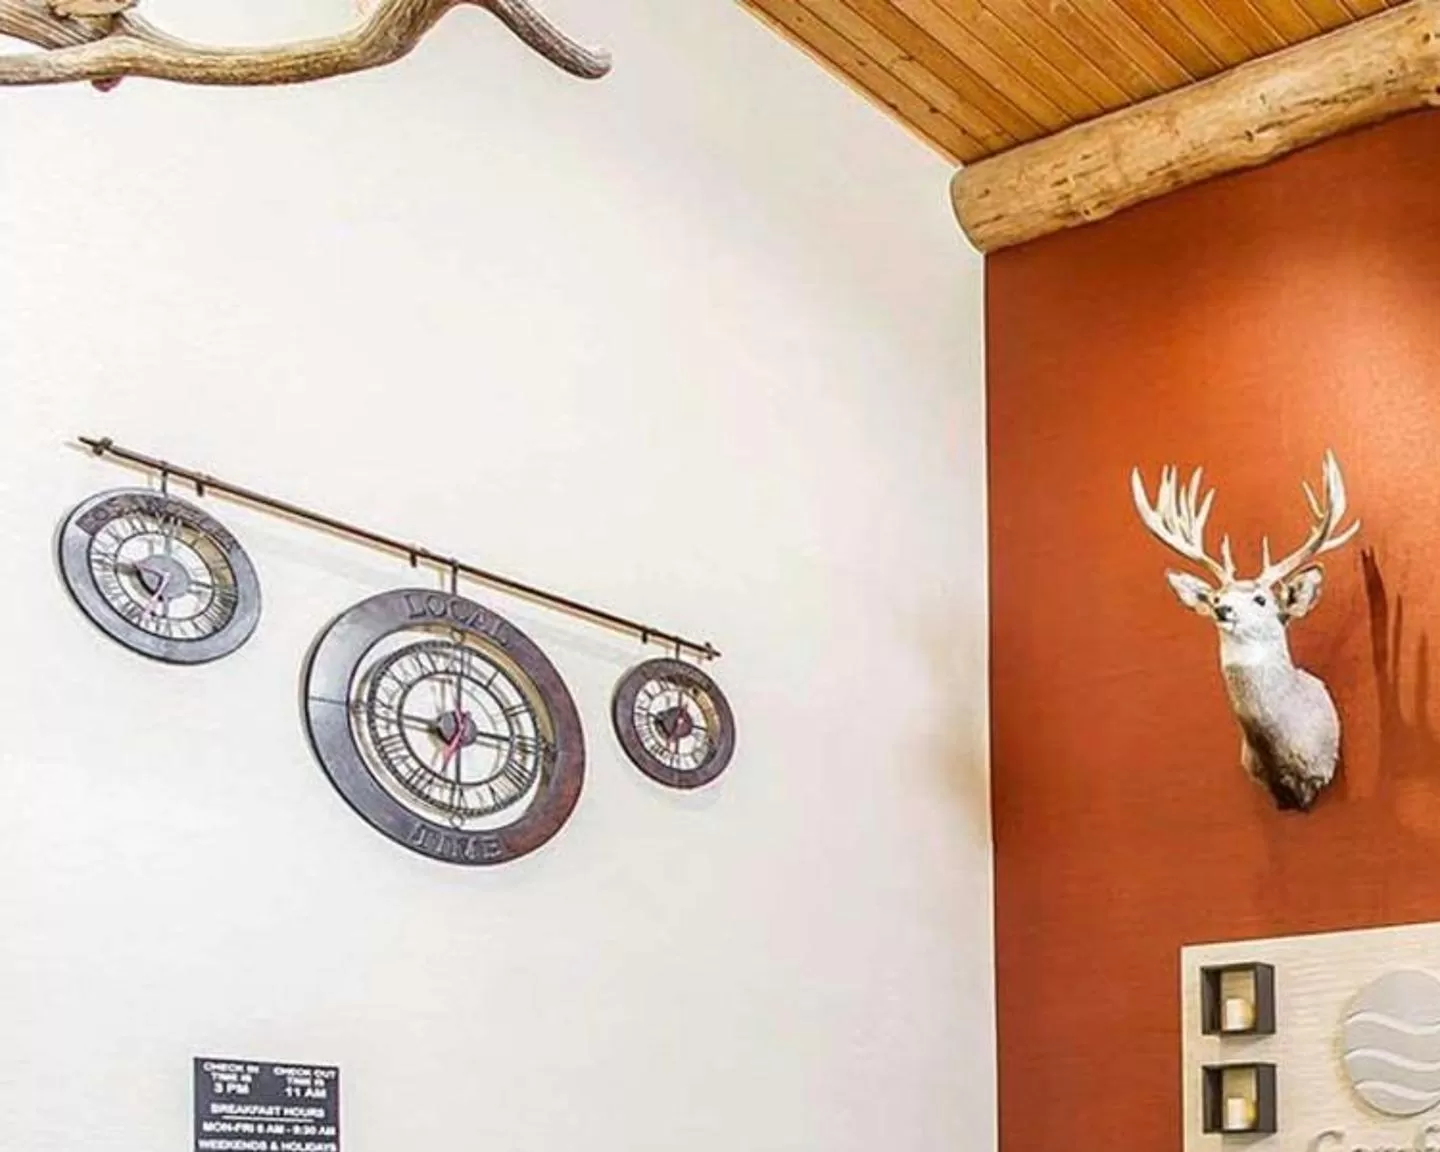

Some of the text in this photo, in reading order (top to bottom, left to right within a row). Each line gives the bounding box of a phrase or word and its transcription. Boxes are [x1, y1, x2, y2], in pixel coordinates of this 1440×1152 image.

[403, 593, 511, 648] LOCAL
[412, 824, 502, 861] TIME
[313, 1070, 336, 1079] OUT
[214, 1082, 250, 1095] 3 PM
[285, 1087, 327, 1099] 11 AM
[210, 1103, 325, 1118] BREAKFAST HOURS
[266, 1124, 285, 1134] AM
[318, 1126, 336, 1136] AM
[198, 1139, 268, 1151] WEEKENDS
[281, 1141, 337, 1152] HOLIDAYS
